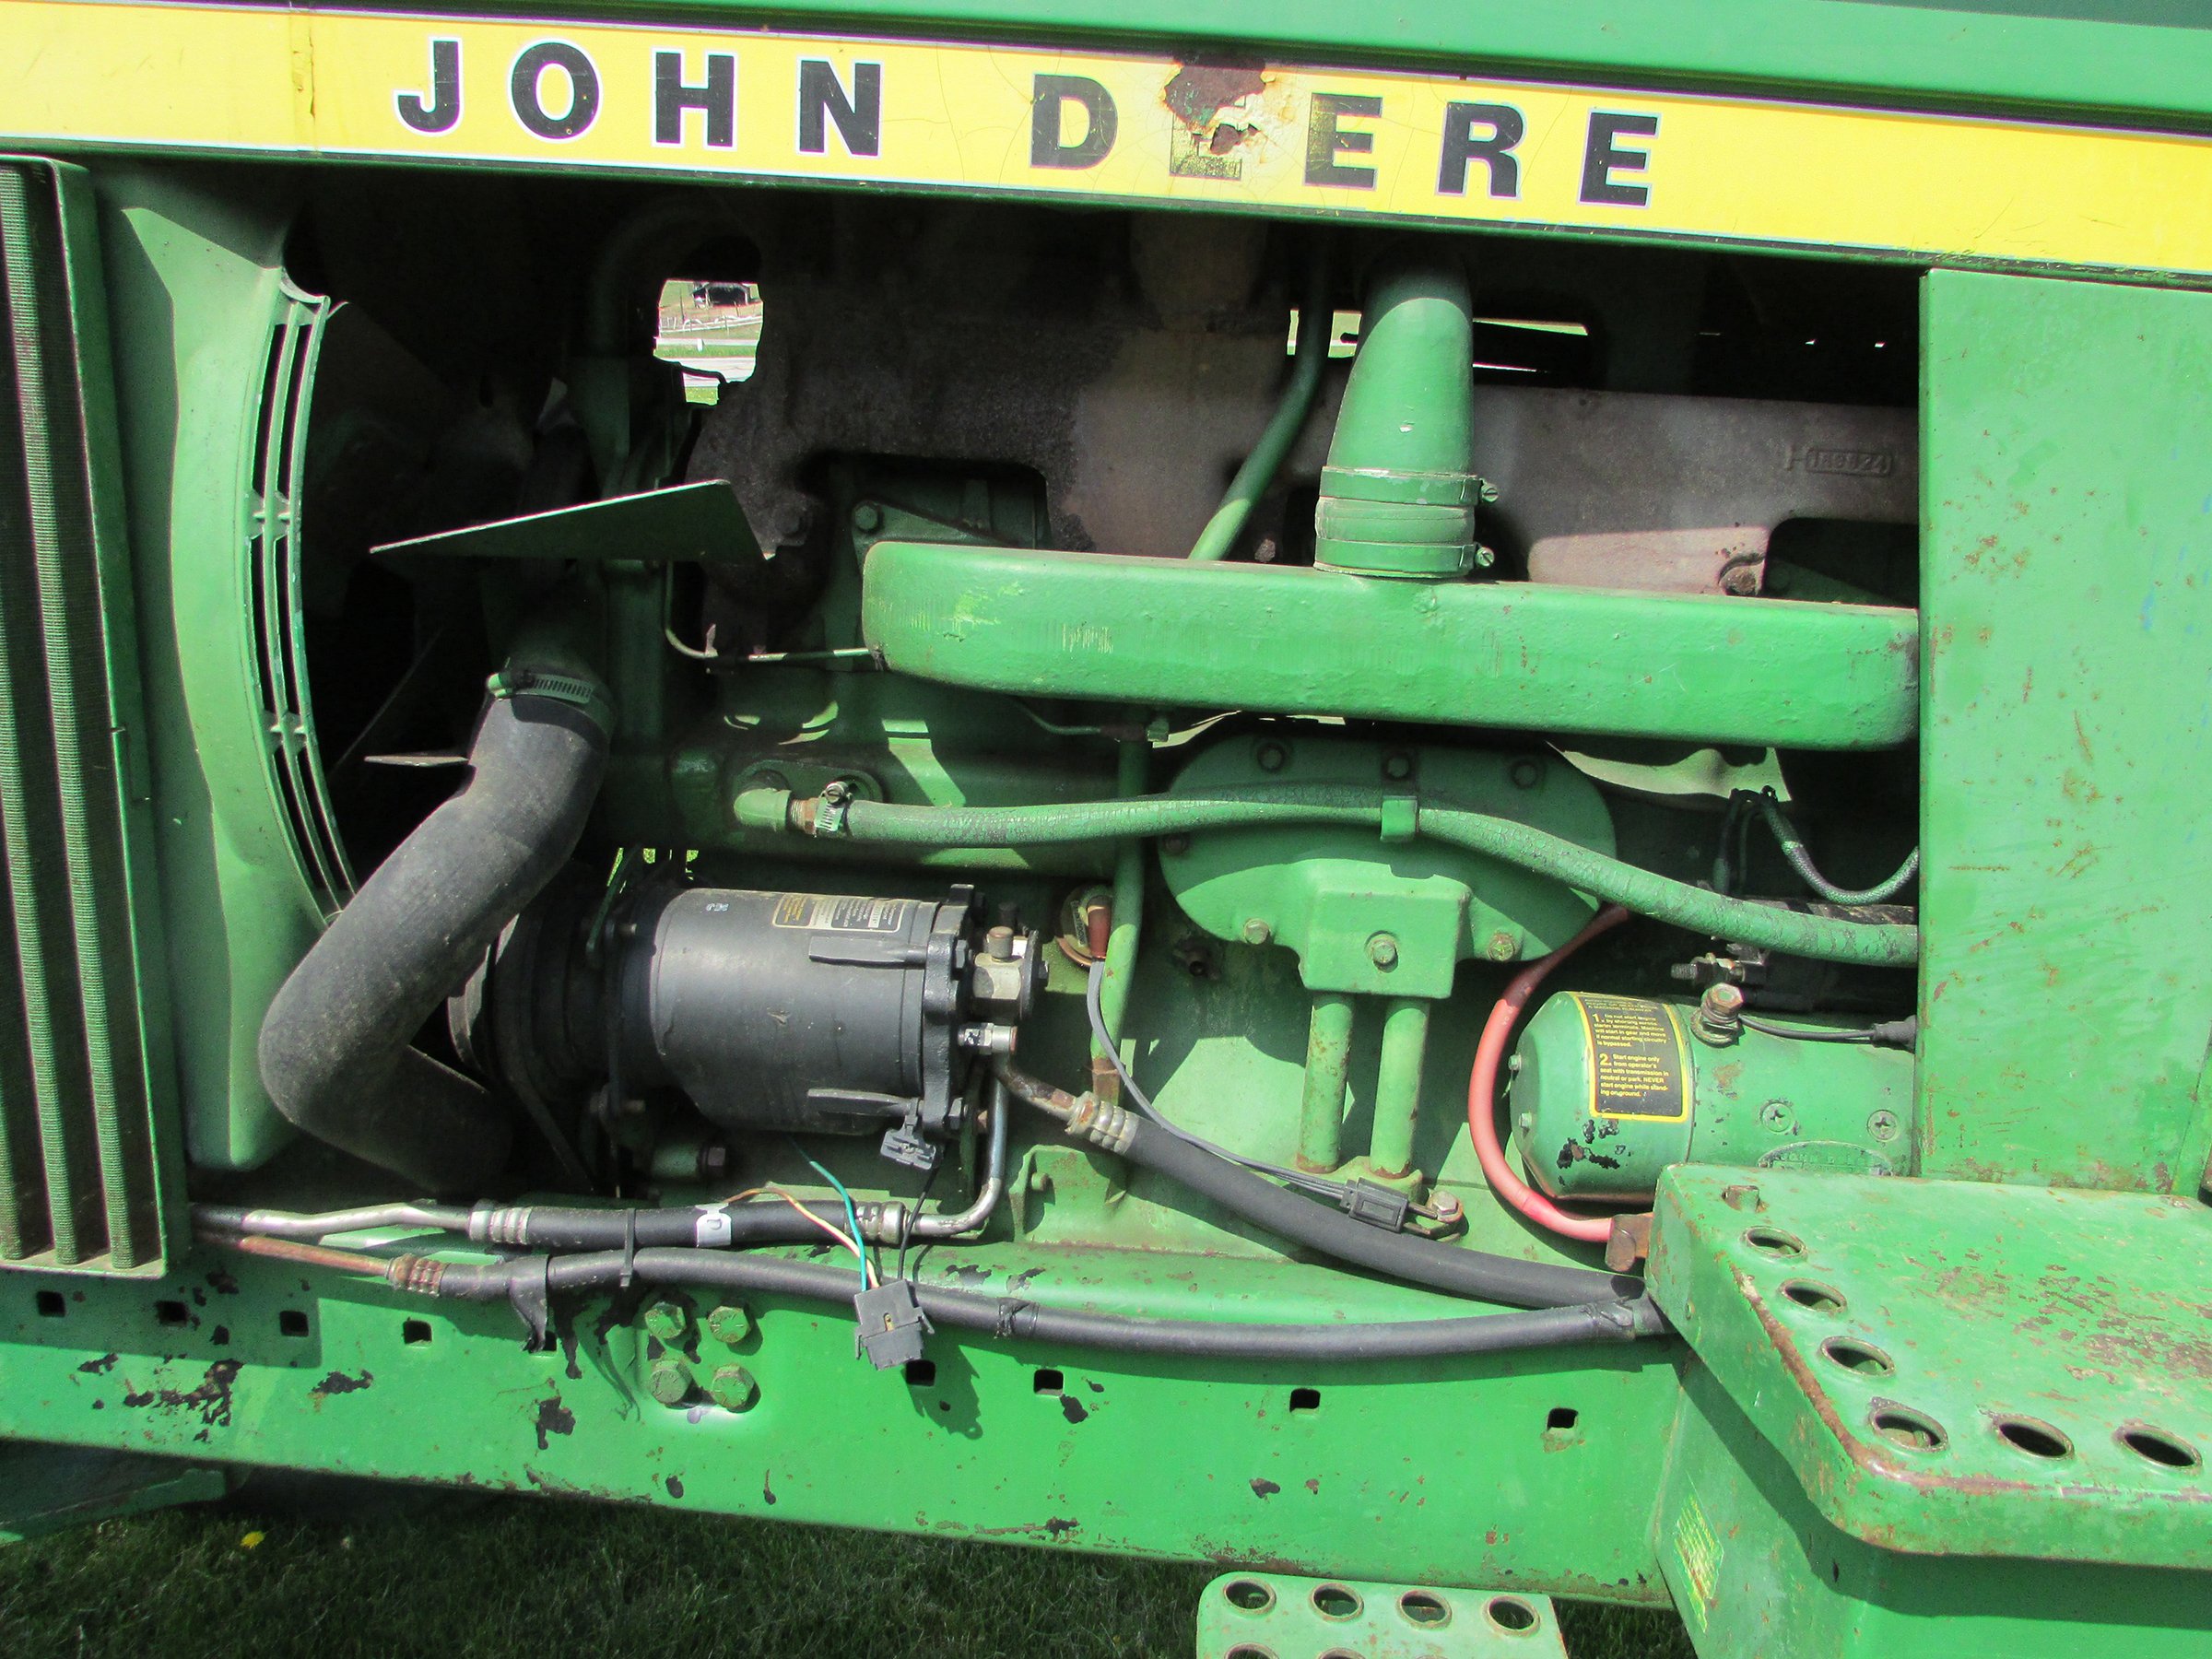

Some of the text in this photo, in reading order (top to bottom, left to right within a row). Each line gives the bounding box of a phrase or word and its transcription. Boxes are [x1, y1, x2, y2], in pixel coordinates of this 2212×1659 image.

[396, 40, 882, 157] JOHN
[1593, 1014, 1605, 1022] 1.
[1599, 1053, 1612, 1065] 2.
